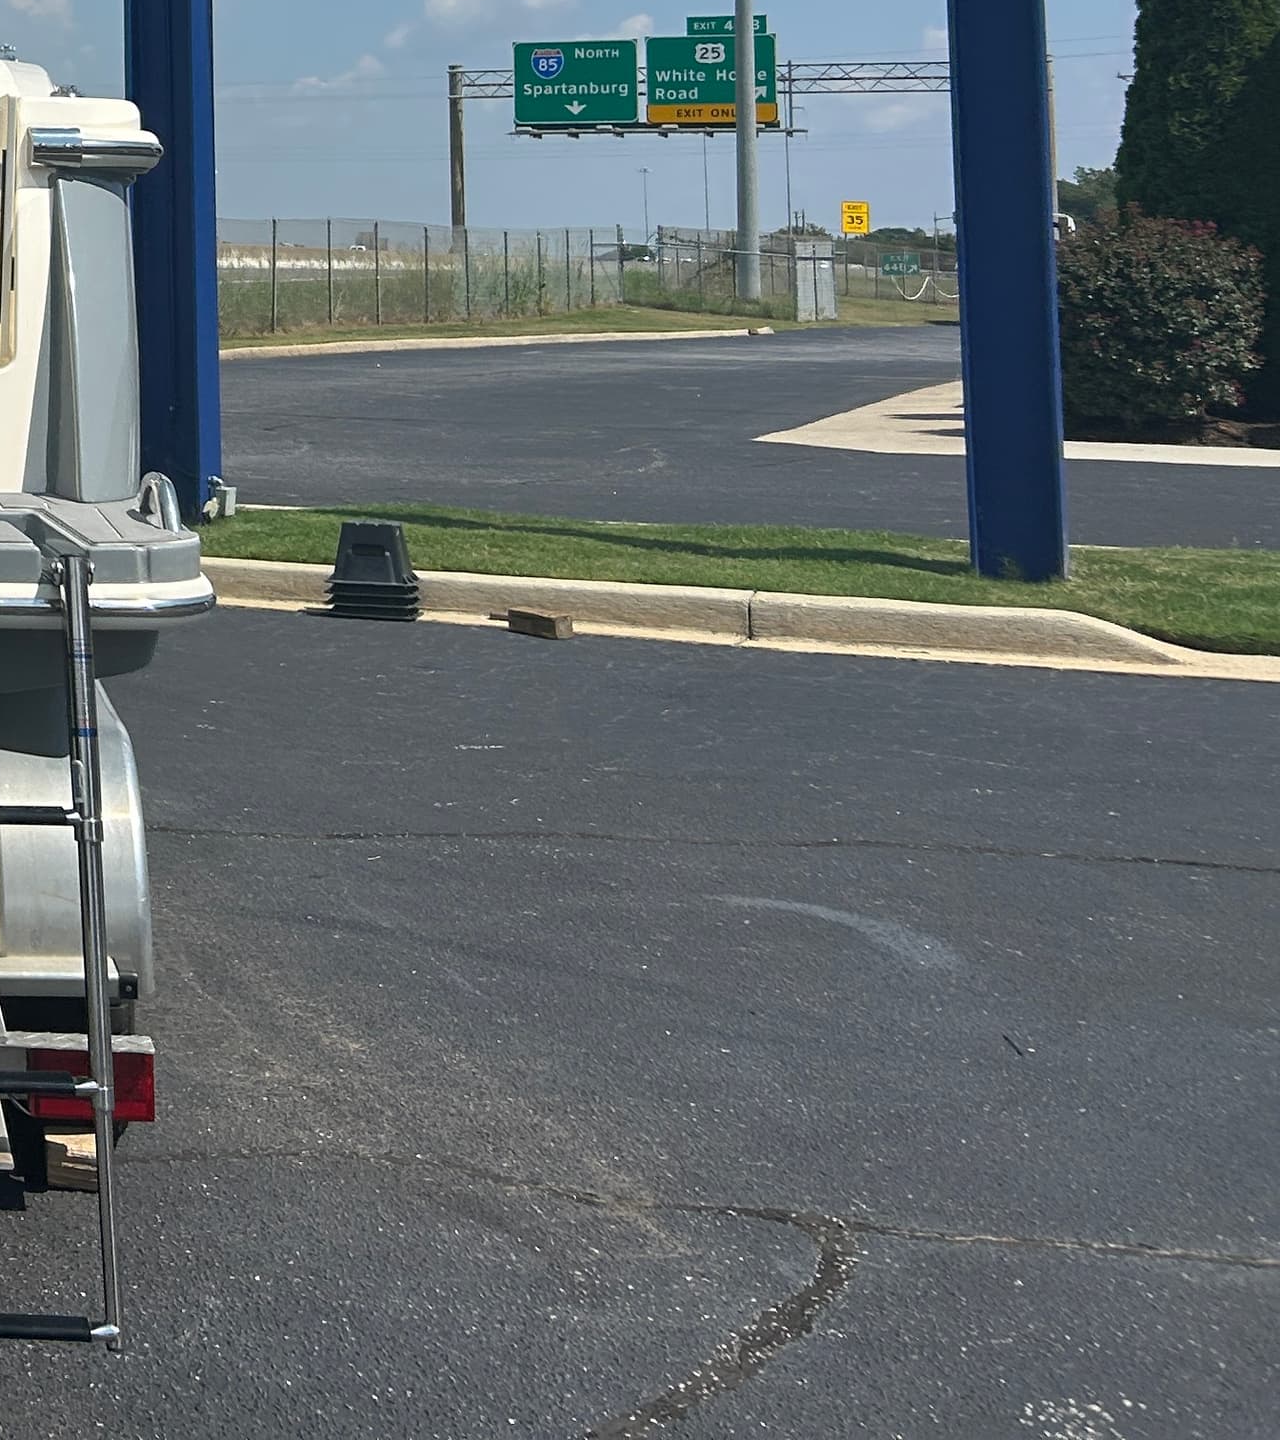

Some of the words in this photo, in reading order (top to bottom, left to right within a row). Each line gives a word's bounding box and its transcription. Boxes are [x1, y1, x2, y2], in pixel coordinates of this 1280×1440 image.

[693, 21, 717, 31] EXIT
[699, 46, 721, 60] 25
[538, 58, 558, 71] 85
[655, 68, 706, 82] White
[716, 69, 767, 82] Hoe
[523, 81, 629, 98] Spartanburg
[655, 86, 699, 100] Road
[676, 108, 704, 118] EXIT
[710, 108, 737, 118] ONL
[846, 215, 864, 225] 35
